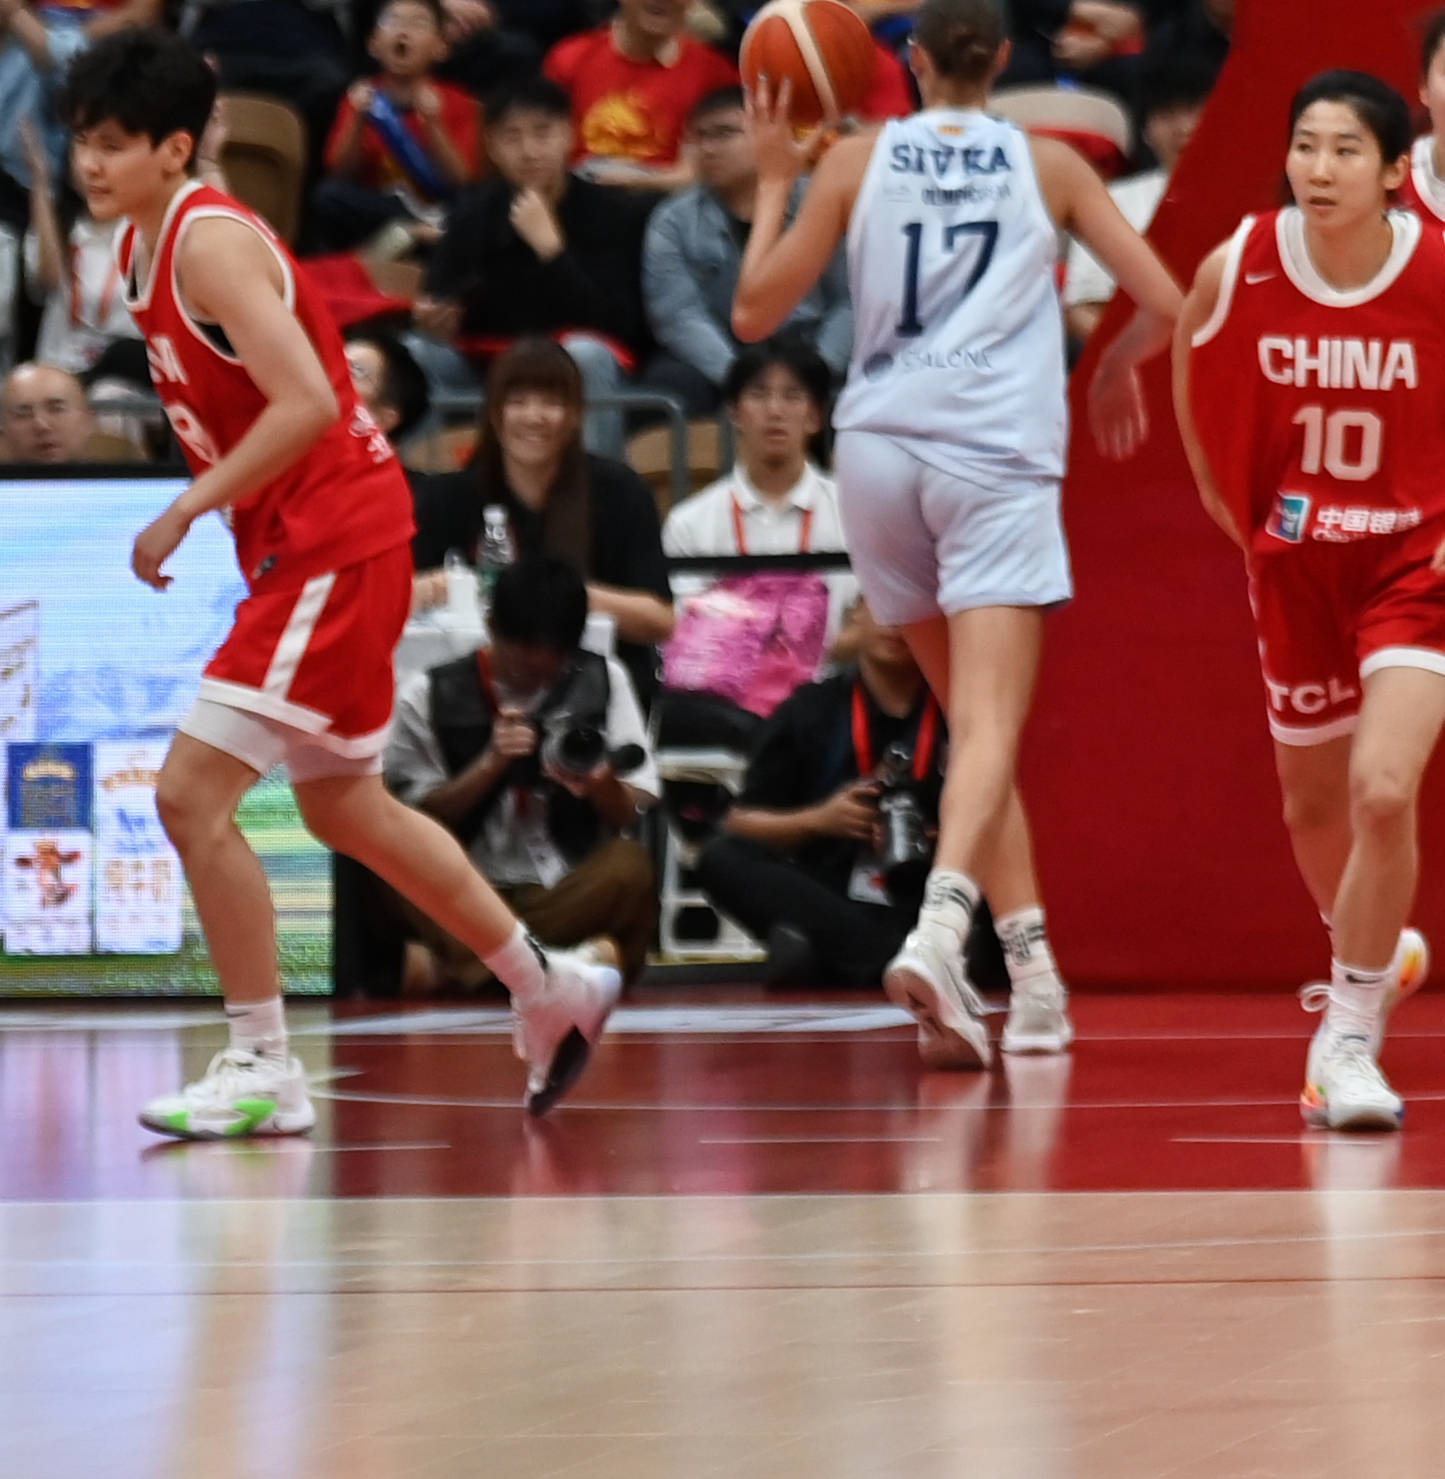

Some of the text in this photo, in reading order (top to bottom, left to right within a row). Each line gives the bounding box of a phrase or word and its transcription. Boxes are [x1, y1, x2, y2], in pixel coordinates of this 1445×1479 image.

[889, 143, 1012, 181] SIVKA
[895, 221, 998, 338] 17
[1257, 336, 1419, 391] CHINA
[1291, 405, 1382, 482] 10
[1267, 677, 1356, 714] TCL
